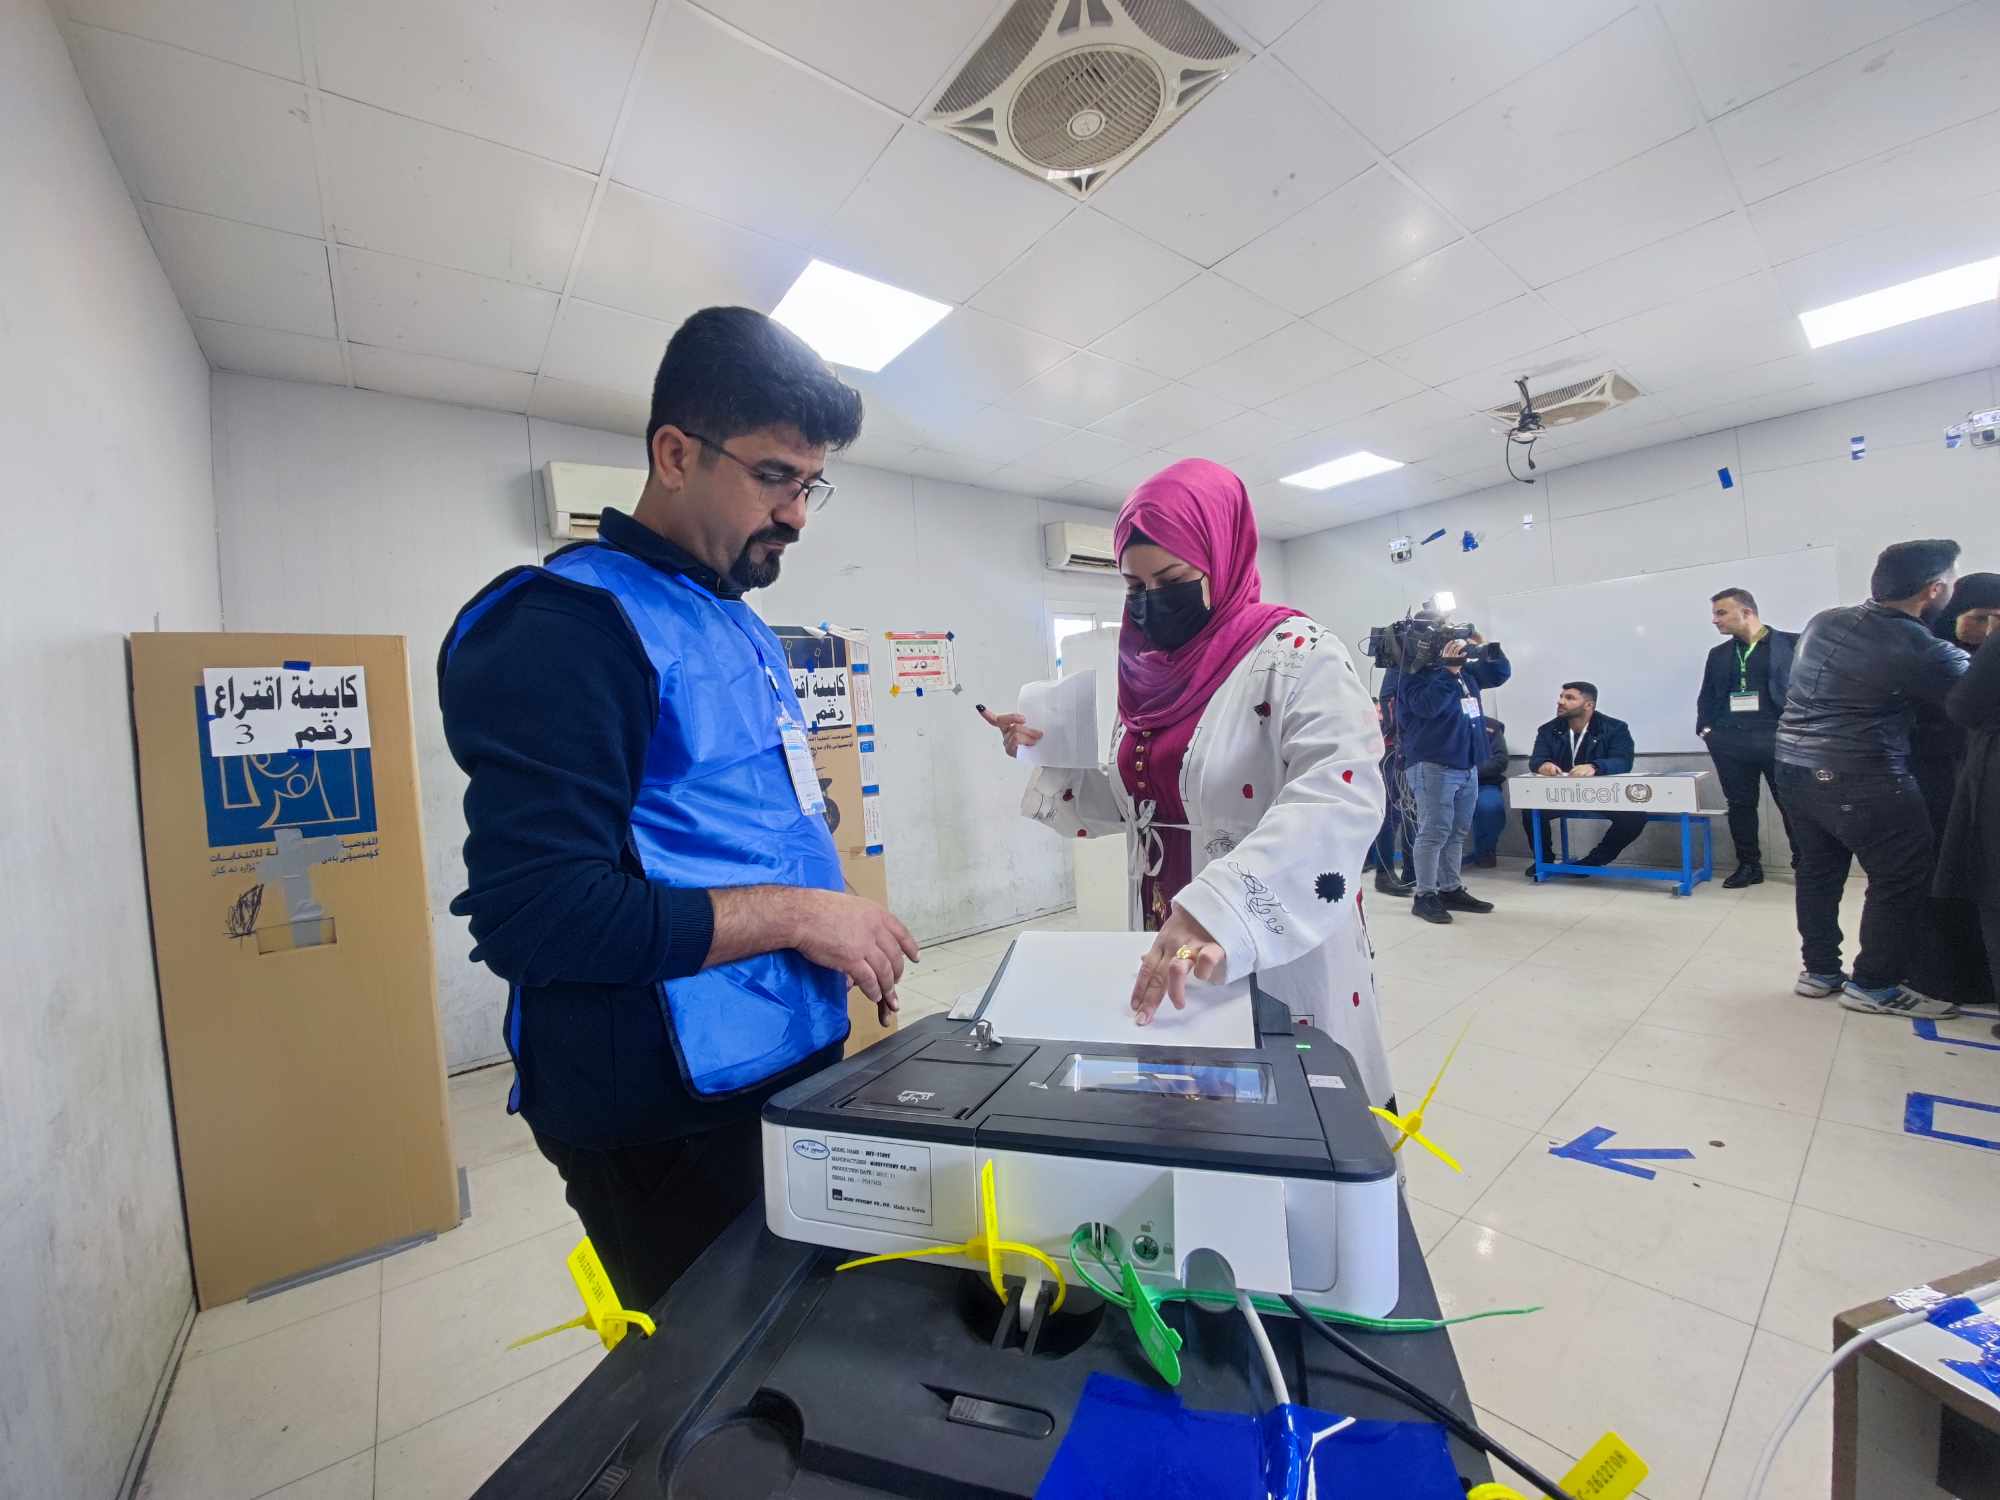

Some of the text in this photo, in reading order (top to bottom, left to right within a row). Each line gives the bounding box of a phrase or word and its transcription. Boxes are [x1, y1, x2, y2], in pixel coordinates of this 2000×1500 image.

[214, 674, 358, 720] كابينة اقتراع
[813, 673, 846, 703] كابينة
[815, 704, 845, 725] رقم
[234, 719, 353, 749] رقم 3
[1545, 783, 1620, 803] unicef
